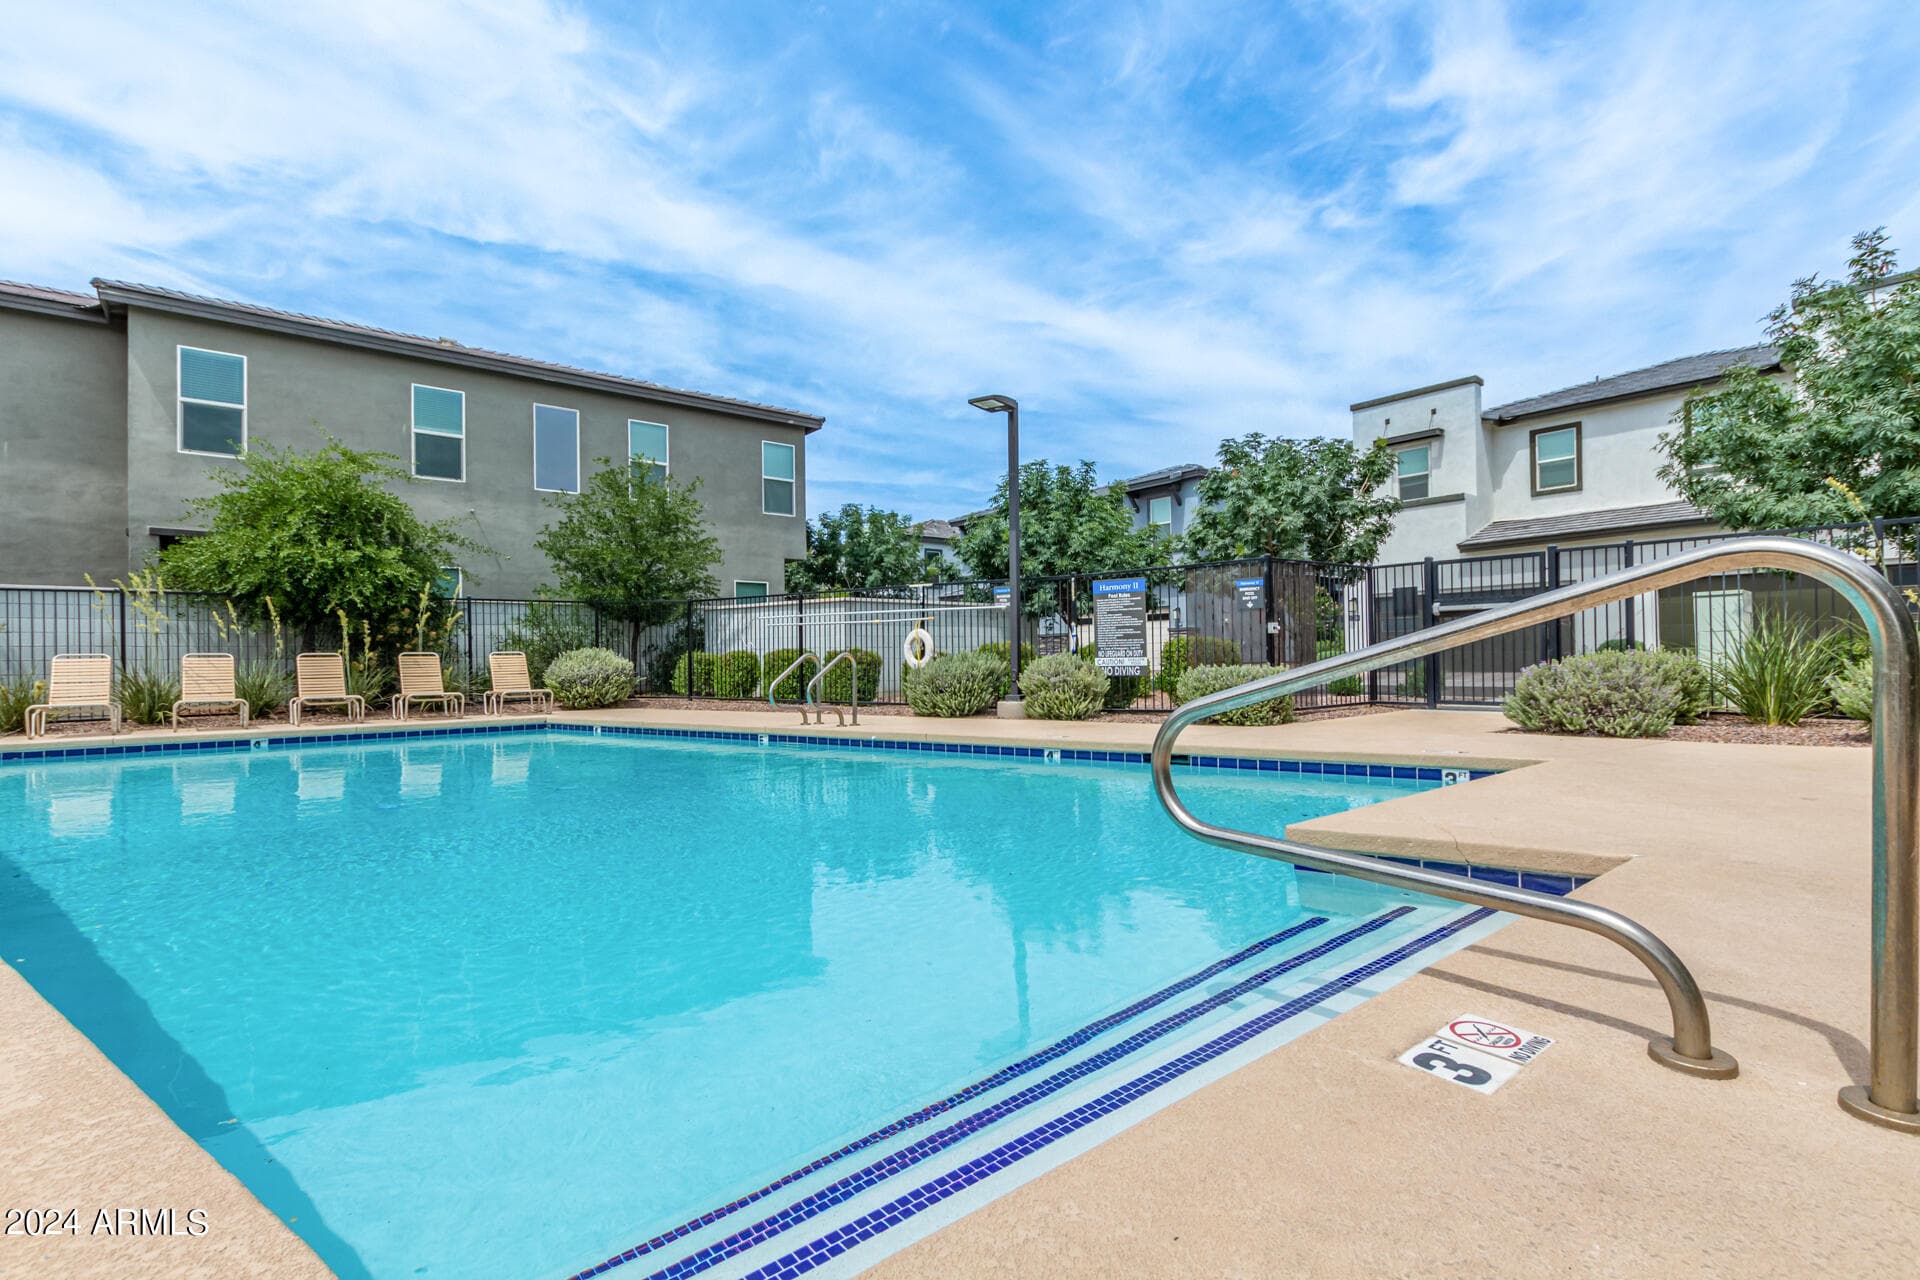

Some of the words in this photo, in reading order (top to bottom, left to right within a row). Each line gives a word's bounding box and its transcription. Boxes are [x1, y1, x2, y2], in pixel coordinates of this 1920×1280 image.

[1099, 584, 1132, 592] Harmony
[1097, 650, 1105, 658] NO
[1105, 650, 1126, 658] LIFEGUARD
[1133, 649, 1144, 657] DUTY
[1114, 666, 1140, 676] DIVING
[1428, 1039, 1458, 1055] FT
[1518, 1036, 1551, 1055] DIVING
[1508, 1051, 1531, 1063] NO
[1412, 1052, 1492, 1085] 3
